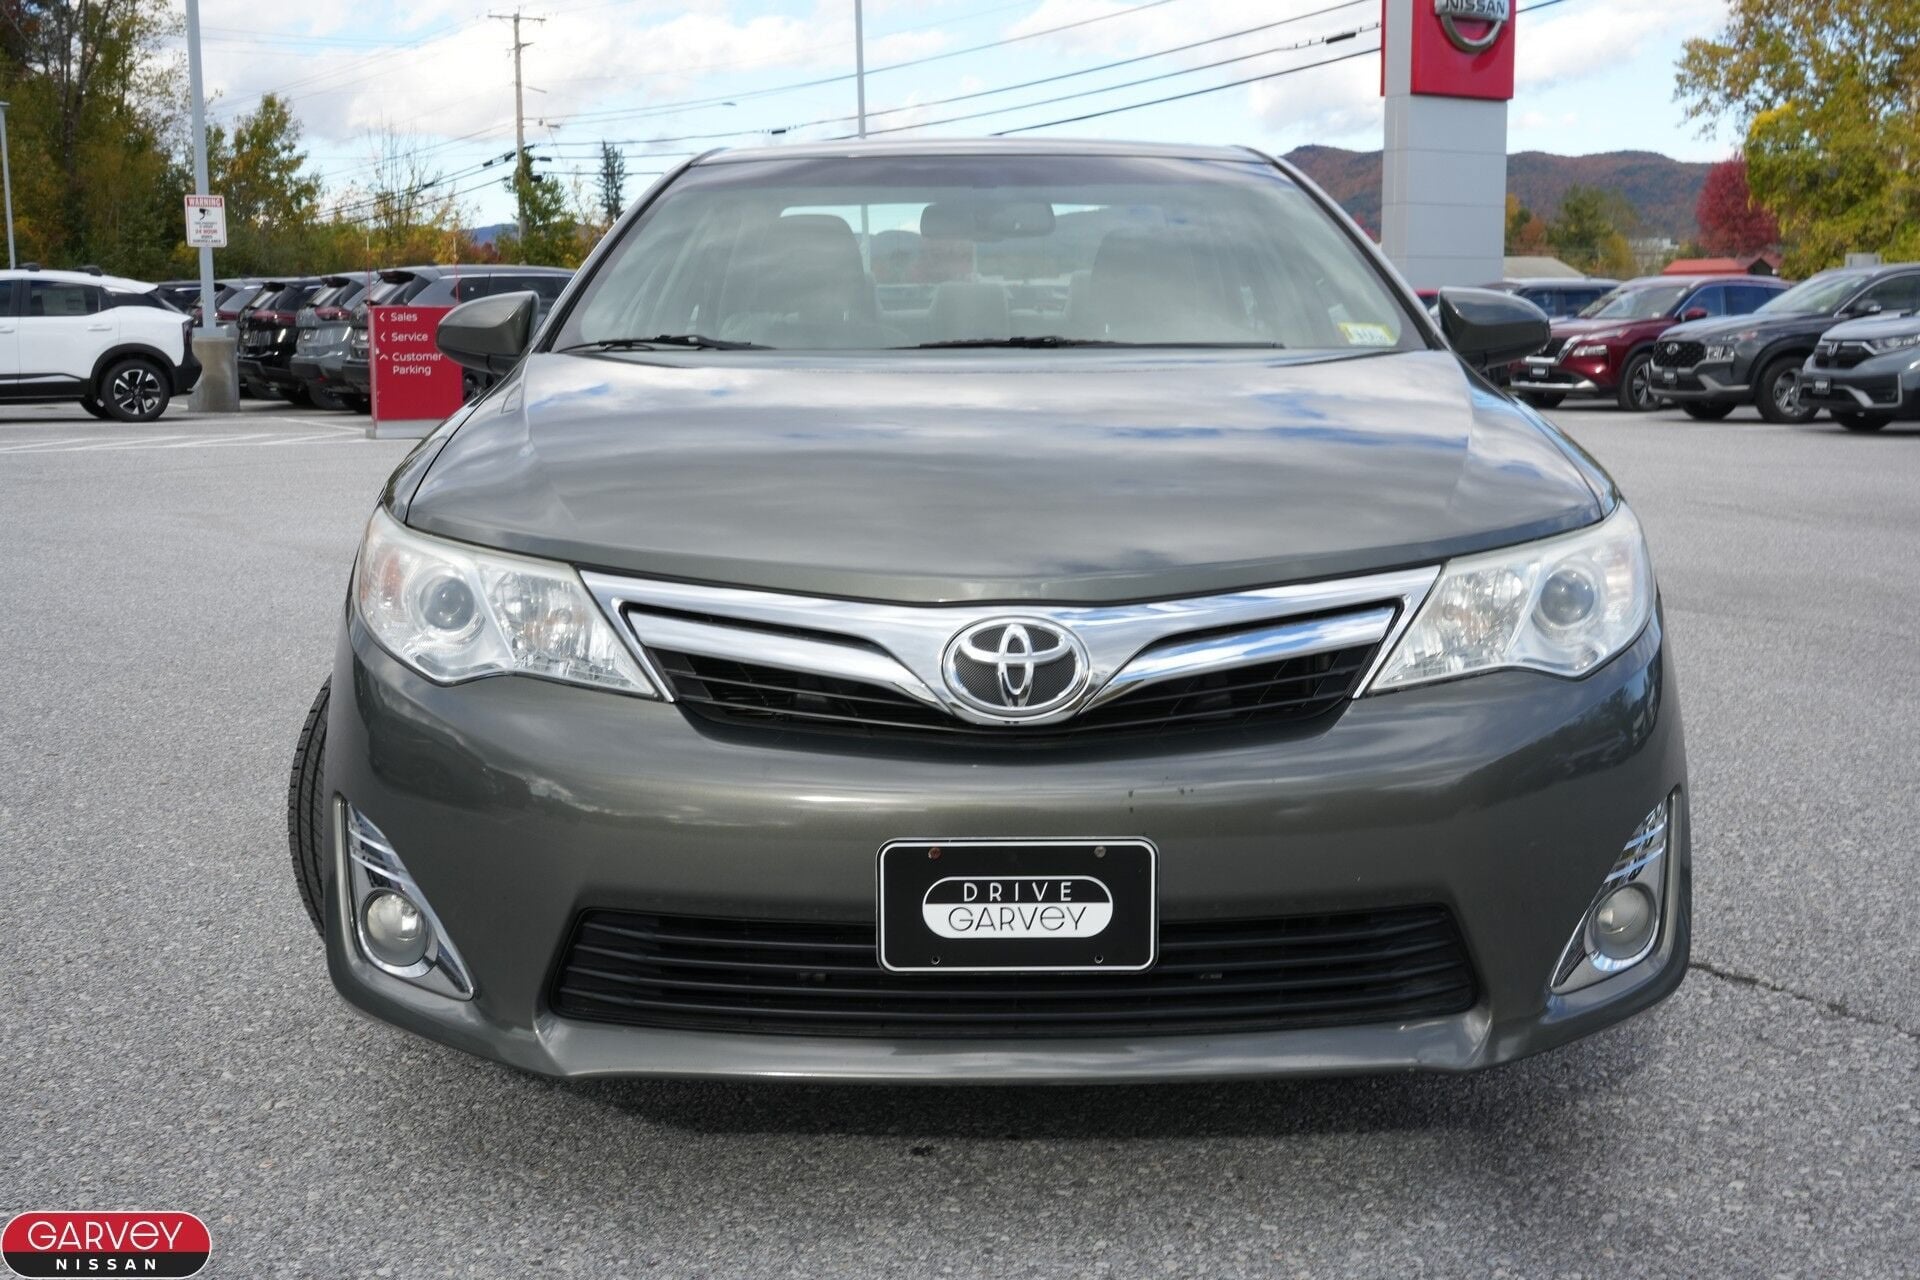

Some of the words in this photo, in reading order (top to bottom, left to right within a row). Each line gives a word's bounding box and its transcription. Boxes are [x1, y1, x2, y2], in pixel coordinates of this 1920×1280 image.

[1446, 0, 1505, 14] NISSAN
[188, 198, 221, 207] WARNING
[390, 312, 417, 322] Sales
[391, 332, 429, 342] Service
[392, 352, 442, 362] Customer
[393, 365, 432, 376] Parking
[963, 882, 1072, 902] DRIVE
